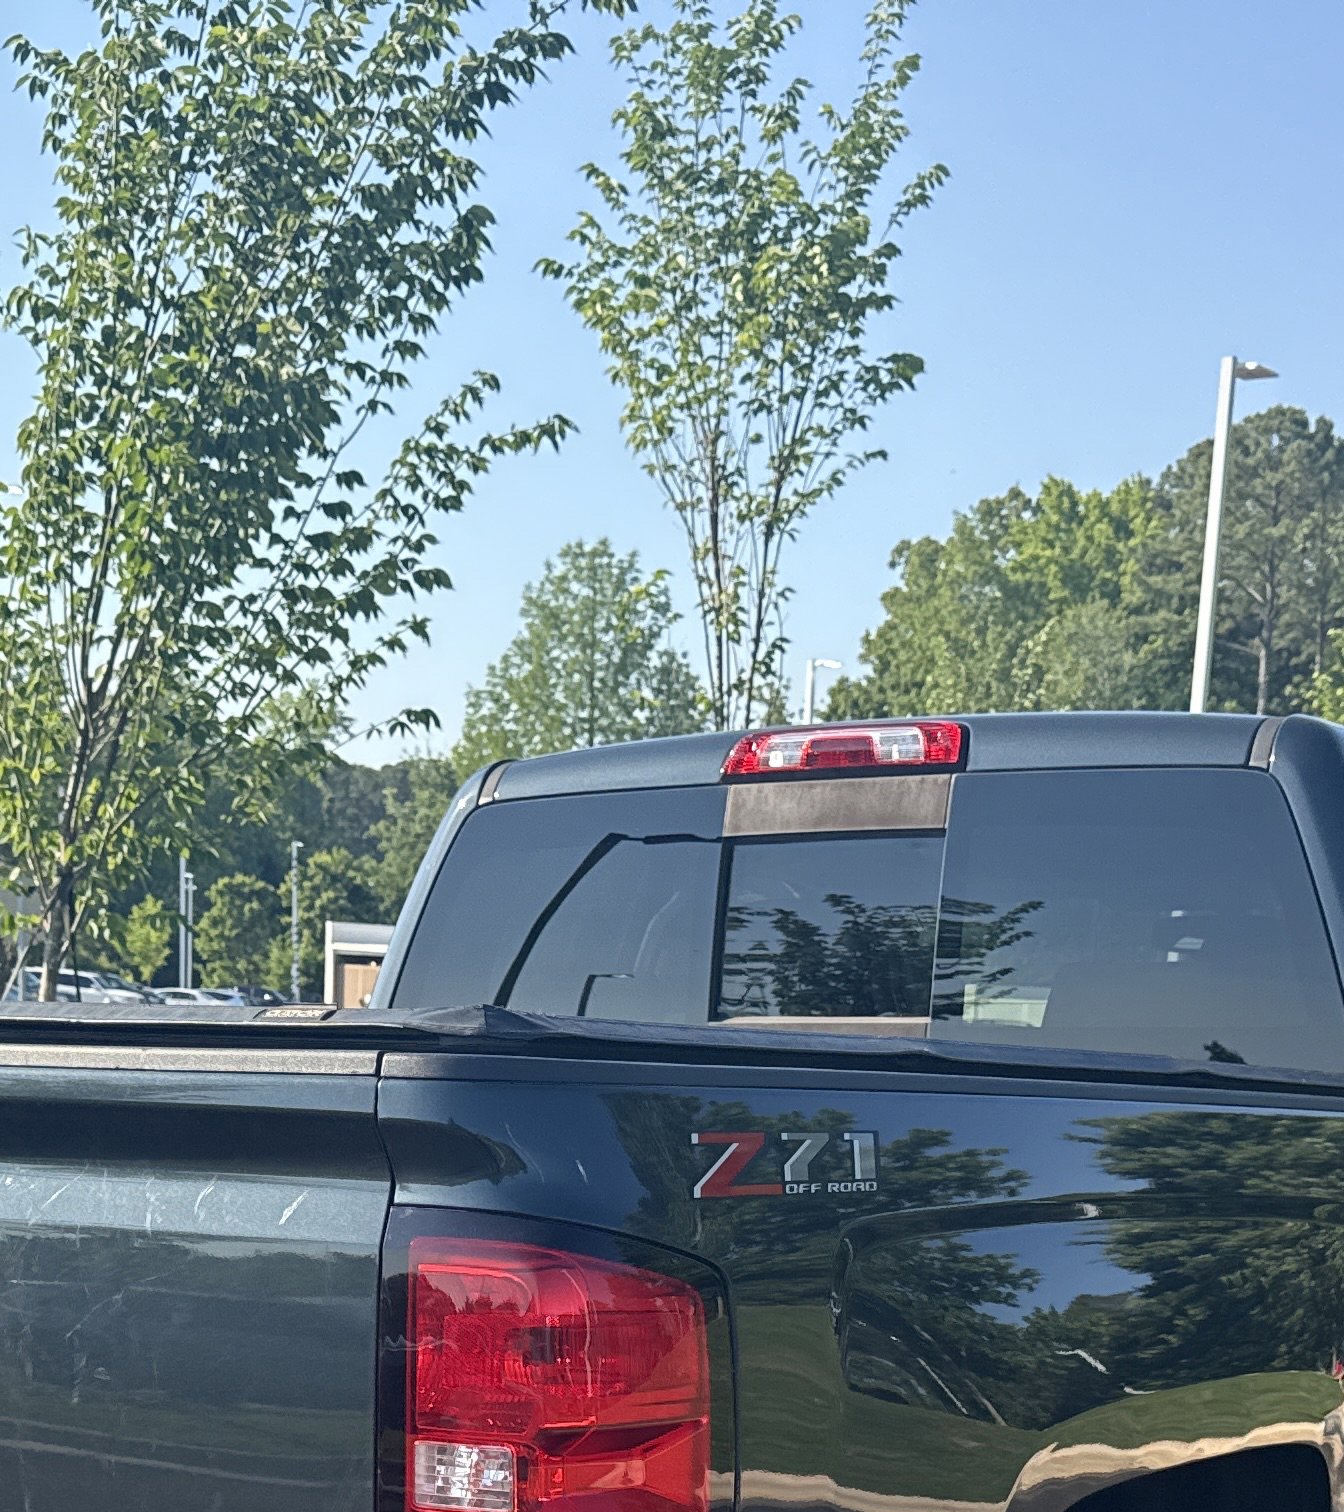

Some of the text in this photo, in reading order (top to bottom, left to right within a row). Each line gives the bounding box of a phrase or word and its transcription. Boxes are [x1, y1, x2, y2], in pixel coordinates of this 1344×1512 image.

[691, 1132, 877, 1198] Z71
[785, 1181, 877, 1194] OFF ROAD
